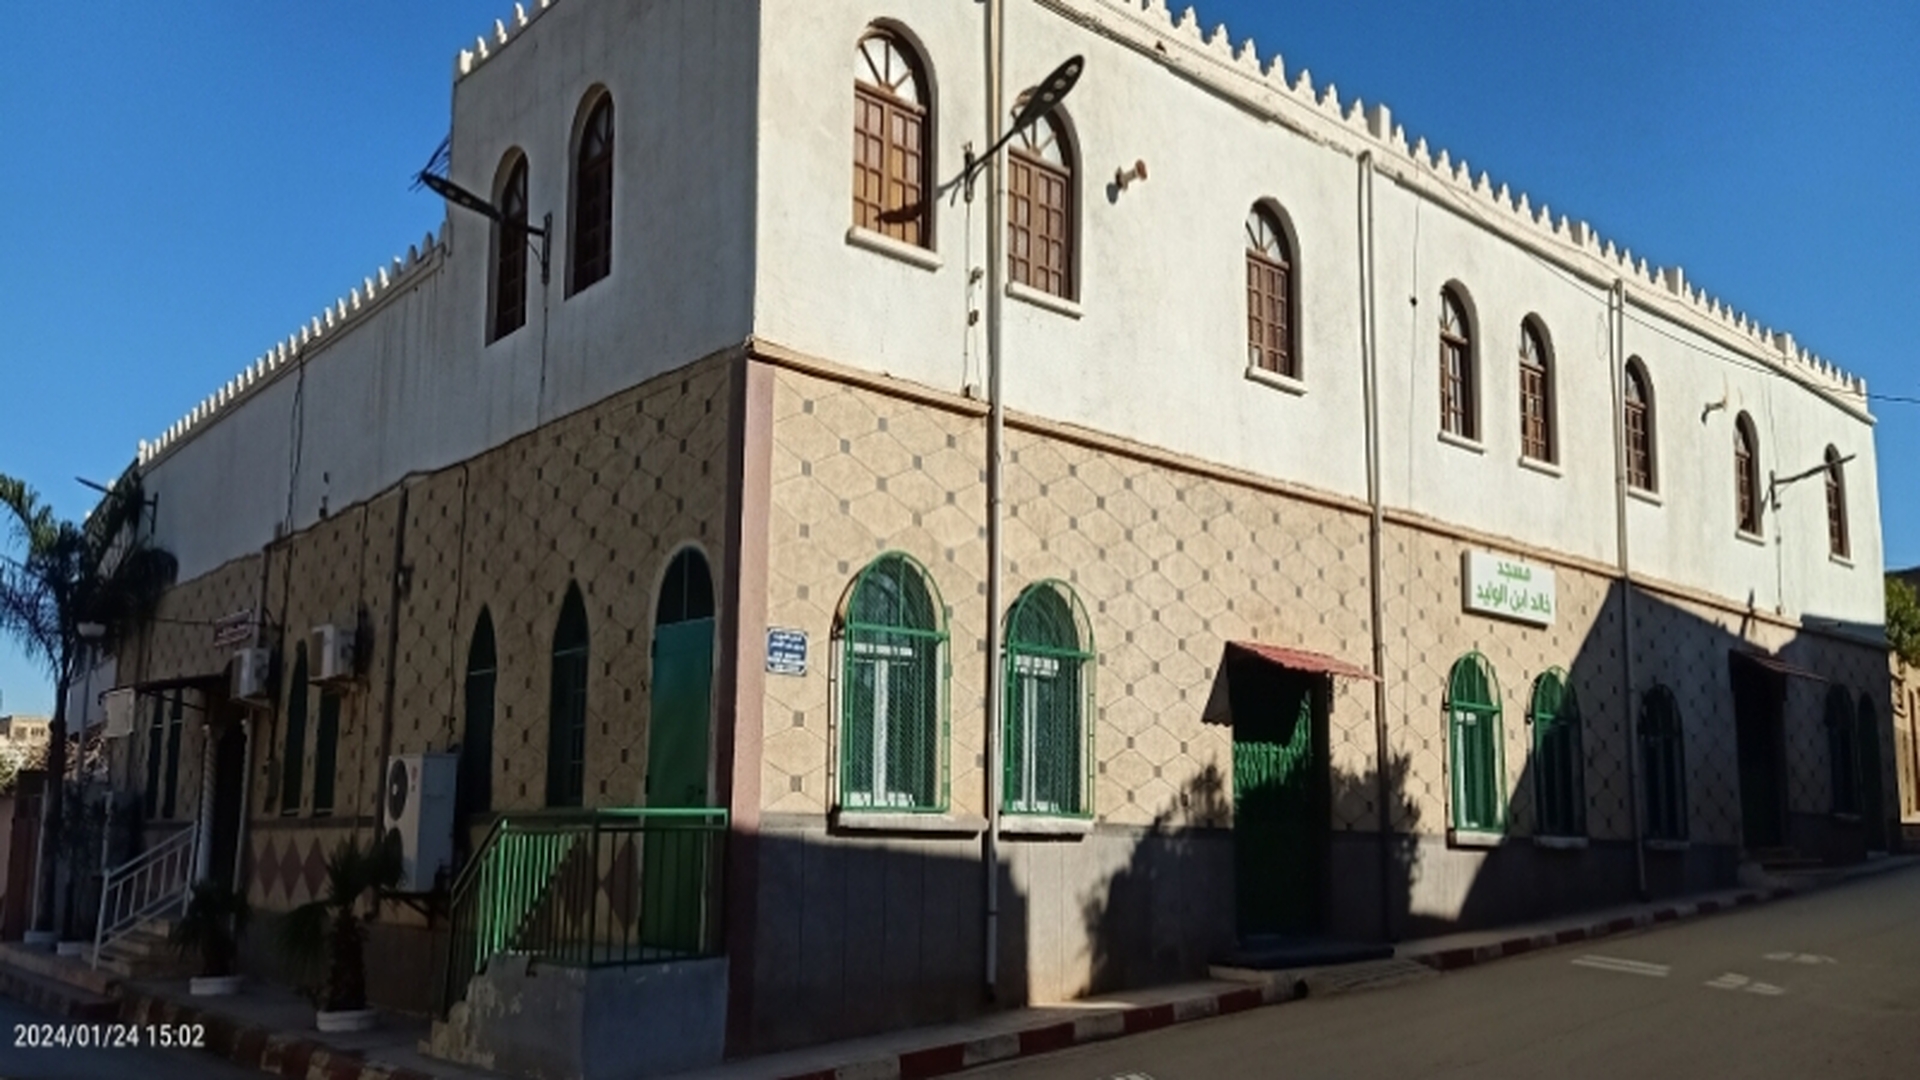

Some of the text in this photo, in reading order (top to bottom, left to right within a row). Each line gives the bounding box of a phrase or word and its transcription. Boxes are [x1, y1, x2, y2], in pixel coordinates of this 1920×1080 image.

[1498, 561, 1531, 582] مسجد
[1477, 581, 1551, 615] خالد ابن الوليد
